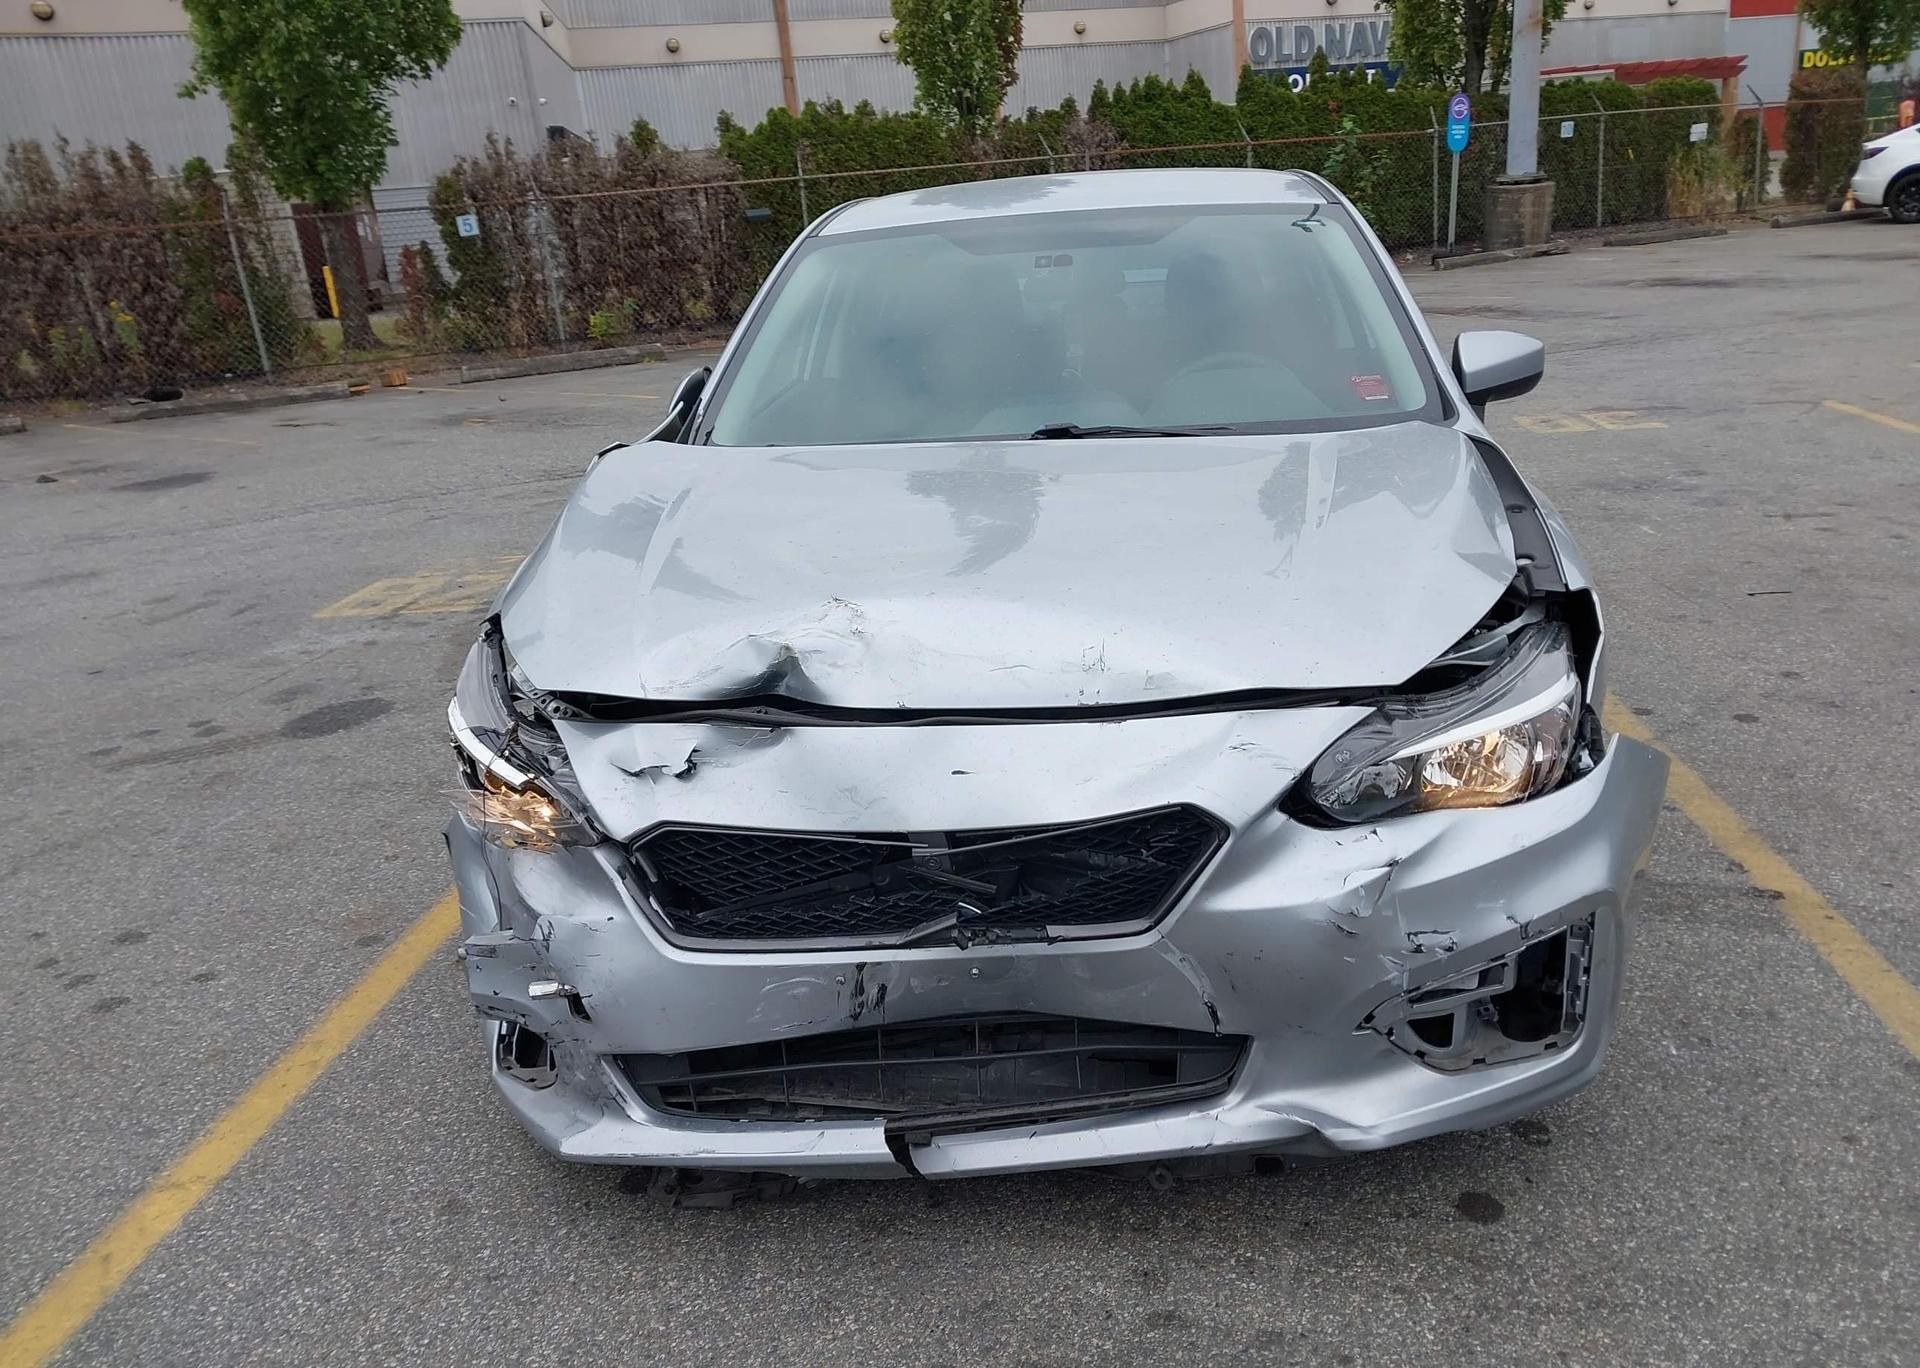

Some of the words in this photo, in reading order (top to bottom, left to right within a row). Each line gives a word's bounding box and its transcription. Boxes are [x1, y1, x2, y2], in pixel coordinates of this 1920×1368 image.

[1249, 25, 1316, 64] OLD
[1324, 20, 1392, 59] NAV
[462, 218, 473, 233] 5
